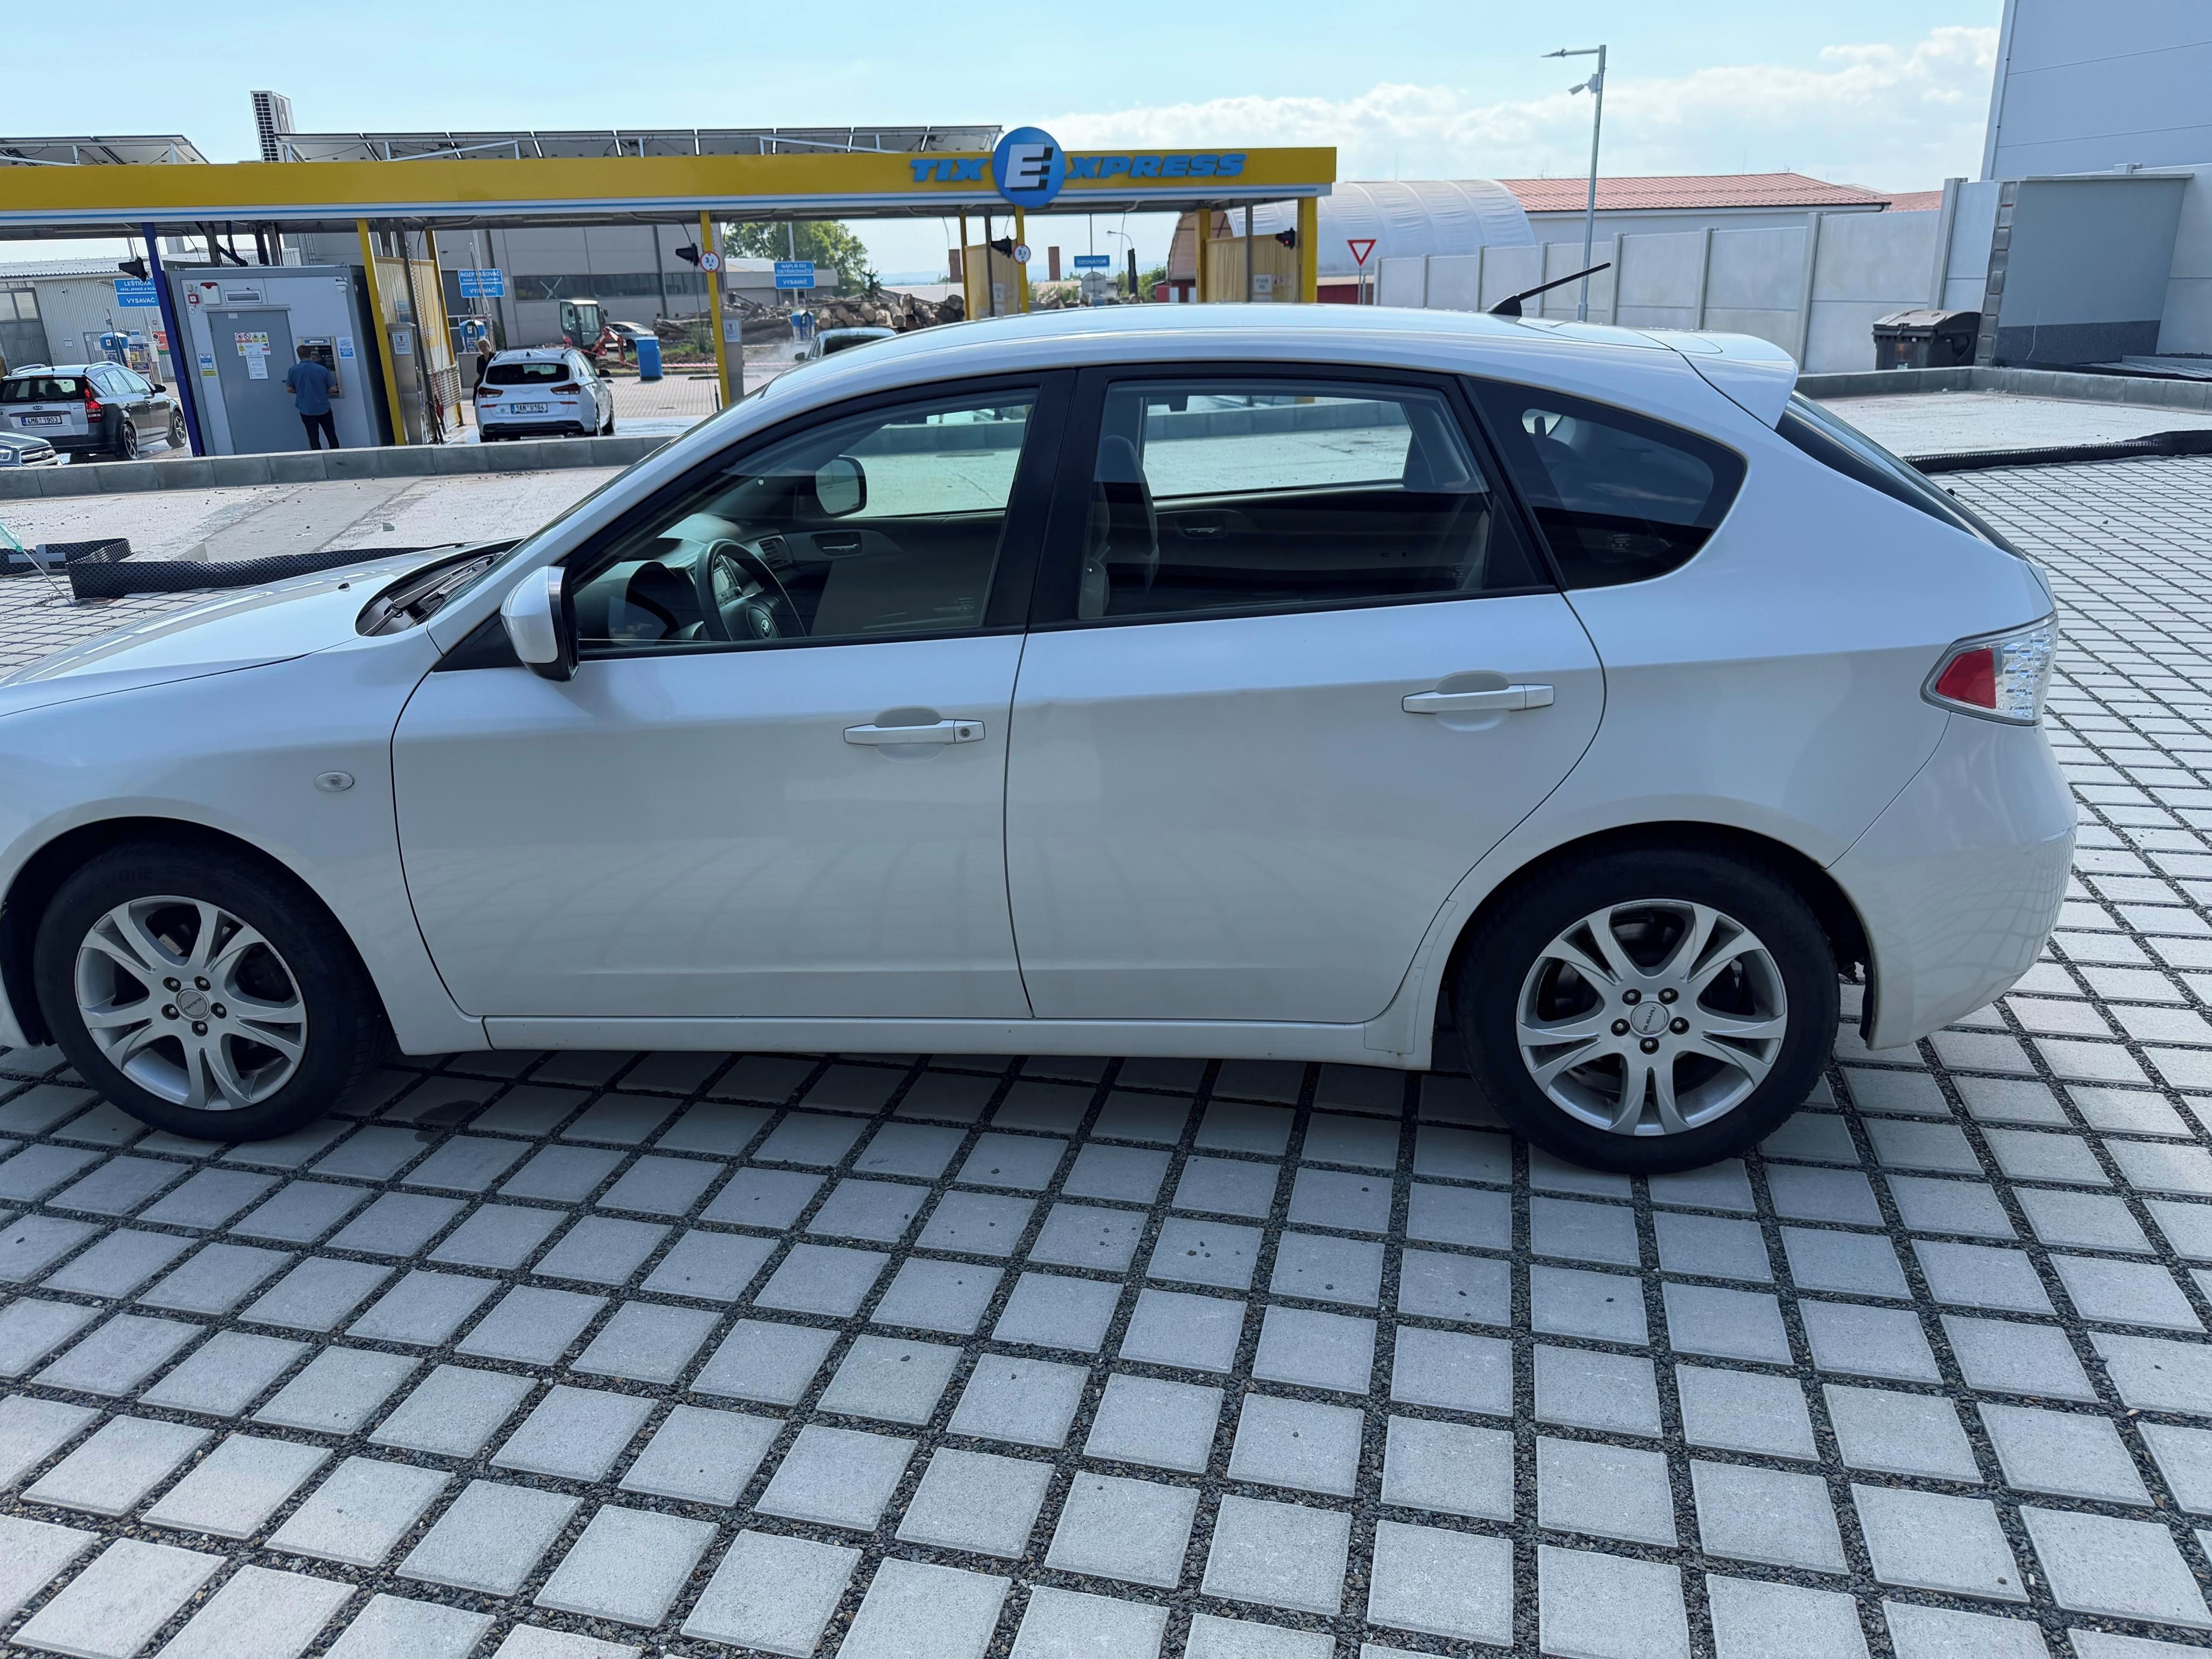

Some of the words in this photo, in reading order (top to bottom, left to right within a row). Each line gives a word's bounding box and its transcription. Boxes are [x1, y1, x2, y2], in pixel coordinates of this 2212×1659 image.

[911, 158, 989, 182] TIX
[43, 416, 59, 424] 1903
[1643, 1006, 1656, 1031] SUBARU
